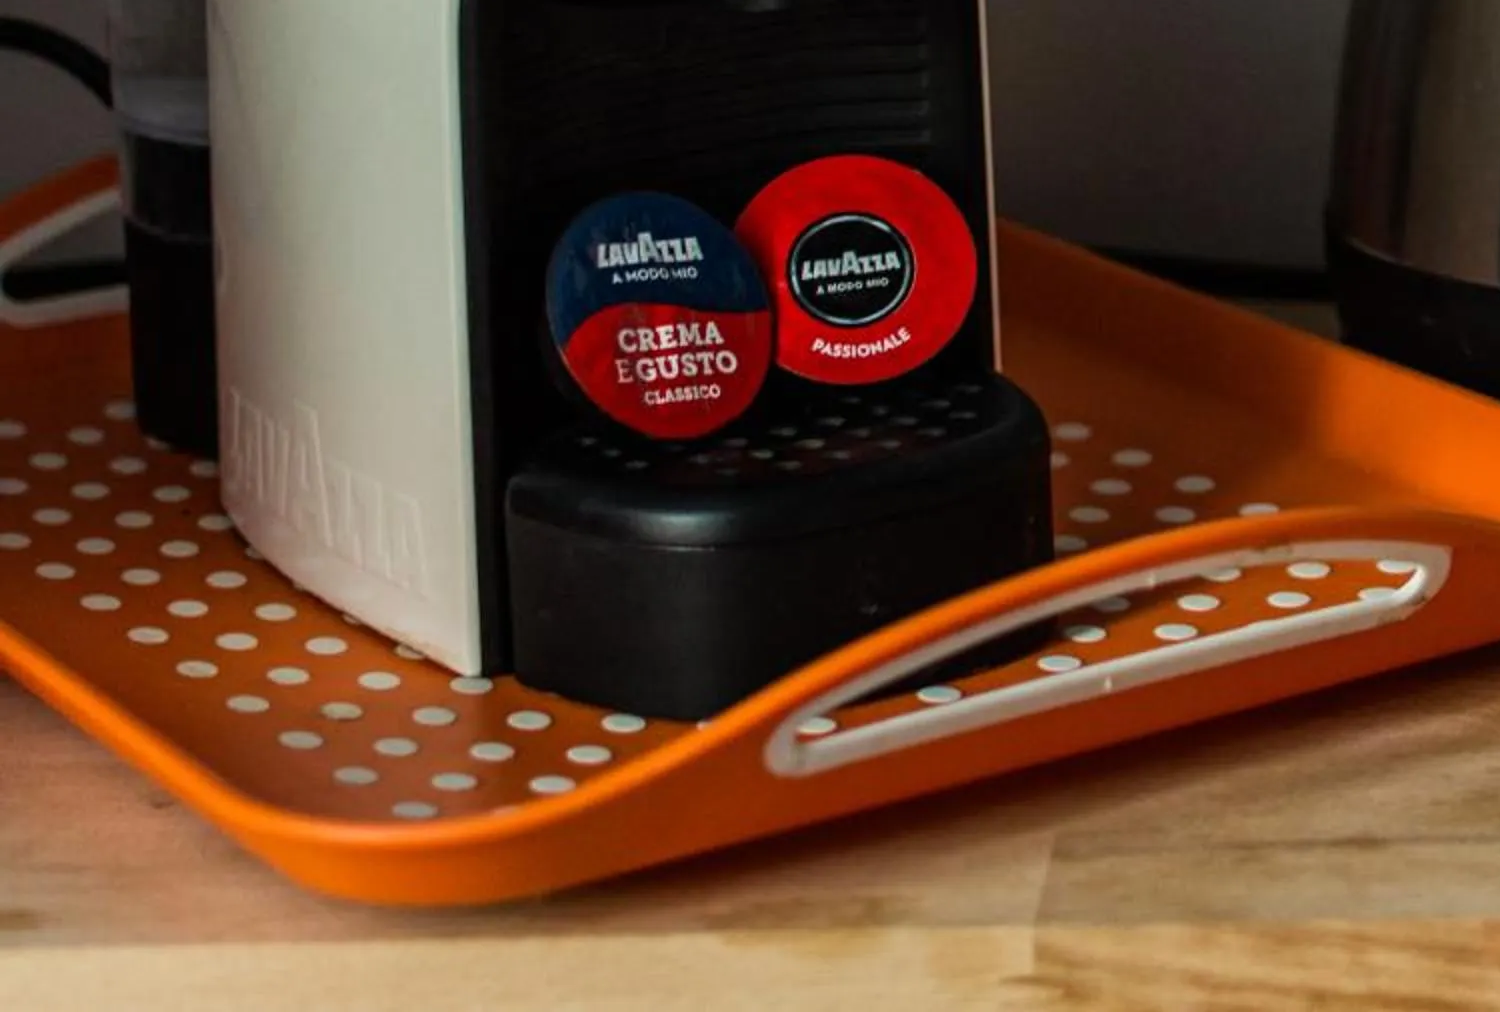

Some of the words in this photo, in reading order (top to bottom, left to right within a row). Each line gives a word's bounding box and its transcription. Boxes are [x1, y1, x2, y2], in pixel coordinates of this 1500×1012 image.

[598, 232, 703, 268] LAVAZZA
[801, 250, 901, 281] LAVAZZA
[612, 271, 623, 285] A
[624, 267, 670, 282] MODO
[816, 285, 825, 295] A
[827, 281, 863, 294] MODO
[617, 321, 724, 353] CREMA
[812, 327, 911, 358] PASSIONALE
[615, 359, 634, 383] E
[636, 350, 738, 382] GUSTO
[644, 384, 721, 405] CLASSICO
